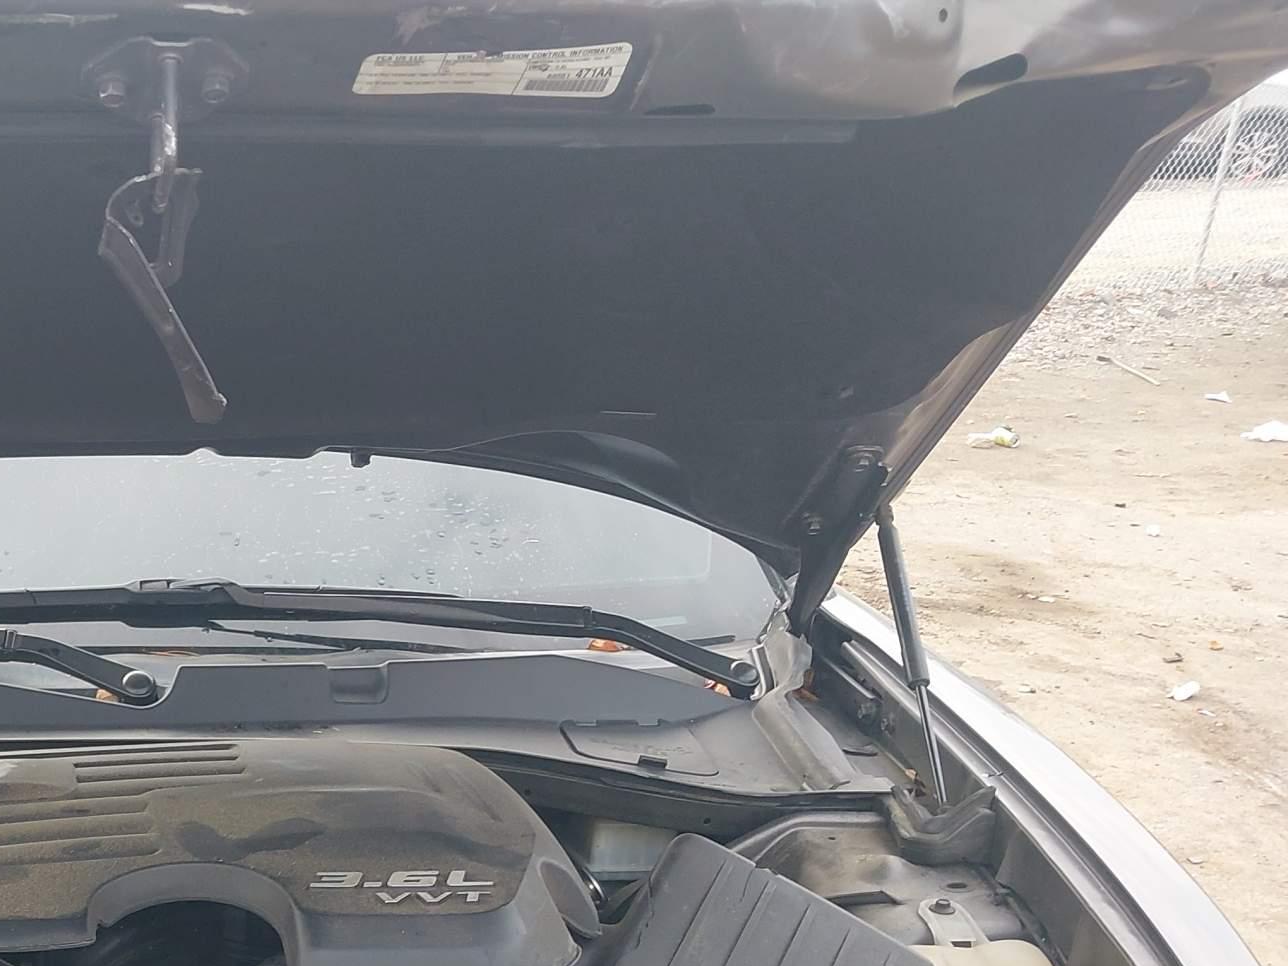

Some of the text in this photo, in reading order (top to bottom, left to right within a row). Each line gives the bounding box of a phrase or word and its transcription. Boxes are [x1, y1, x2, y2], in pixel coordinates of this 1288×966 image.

[531, 51, 566, 59] CONTROL
[569, 46, 624, 57] INFORMATION
[575, 66, 614, 79] 471AA
[309, 869, 495, 889] 3.6L
[375, 891, 492, 904] VVT
